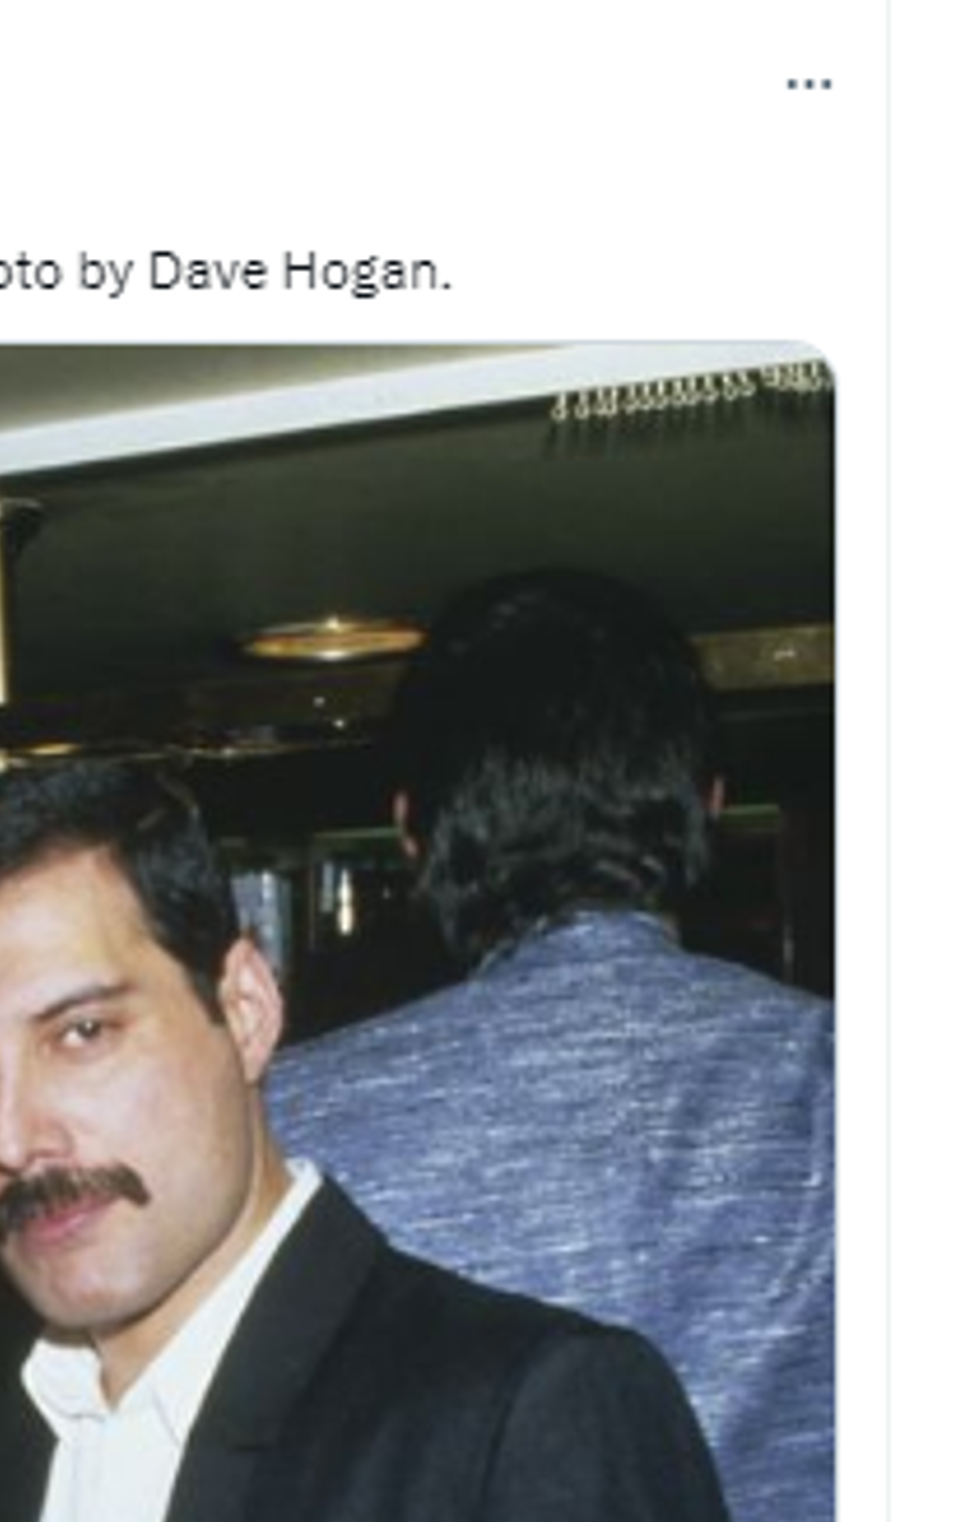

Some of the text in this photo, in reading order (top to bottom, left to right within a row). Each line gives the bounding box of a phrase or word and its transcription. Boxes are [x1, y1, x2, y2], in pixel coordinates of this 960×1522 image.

[80, 252, 134, 299] by
[151, 250, 268, 290] Dave
[285, 251, 451, 299] Hogan.
